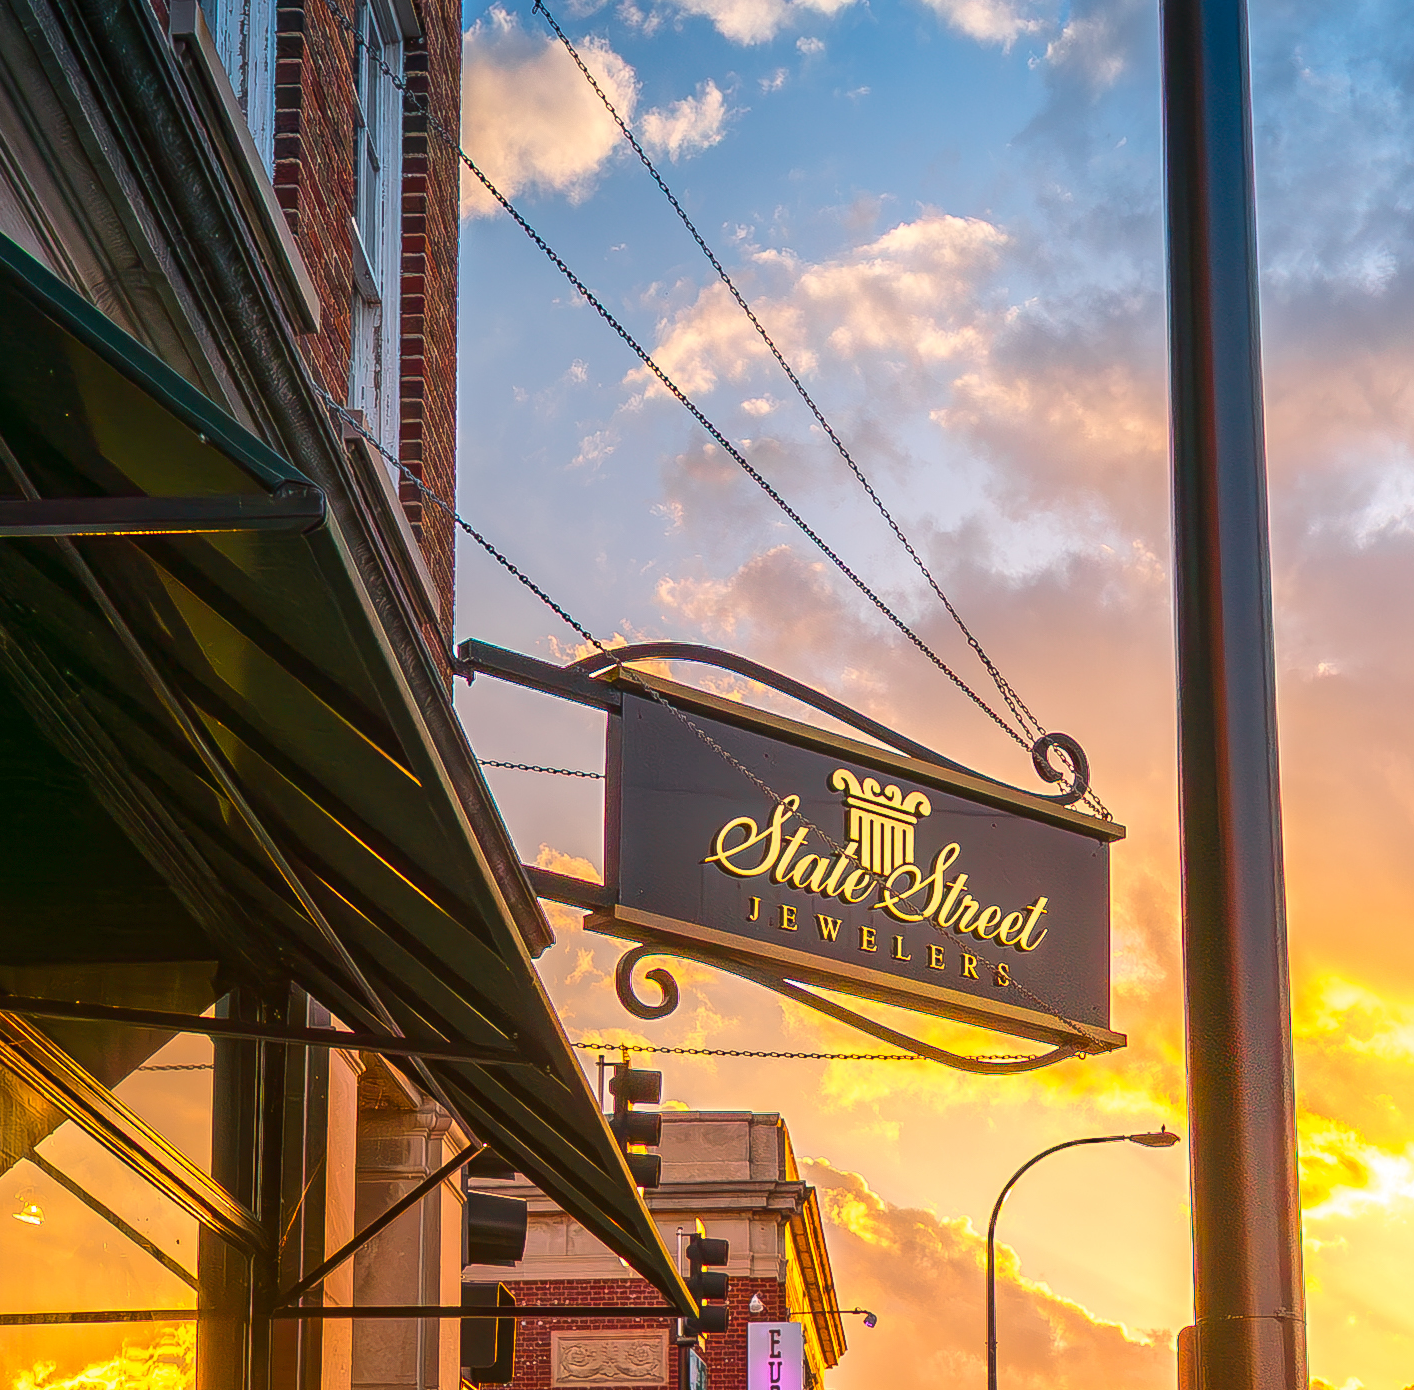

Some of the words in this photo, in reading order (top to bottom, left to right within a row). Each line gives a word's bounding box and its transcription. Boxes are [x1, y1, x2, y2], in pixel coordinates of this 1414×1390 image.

[705, 794, 877, 902] State
[874, 842, 1049, 952] Street
[748, 897, 1010, 987] JEWELERS
